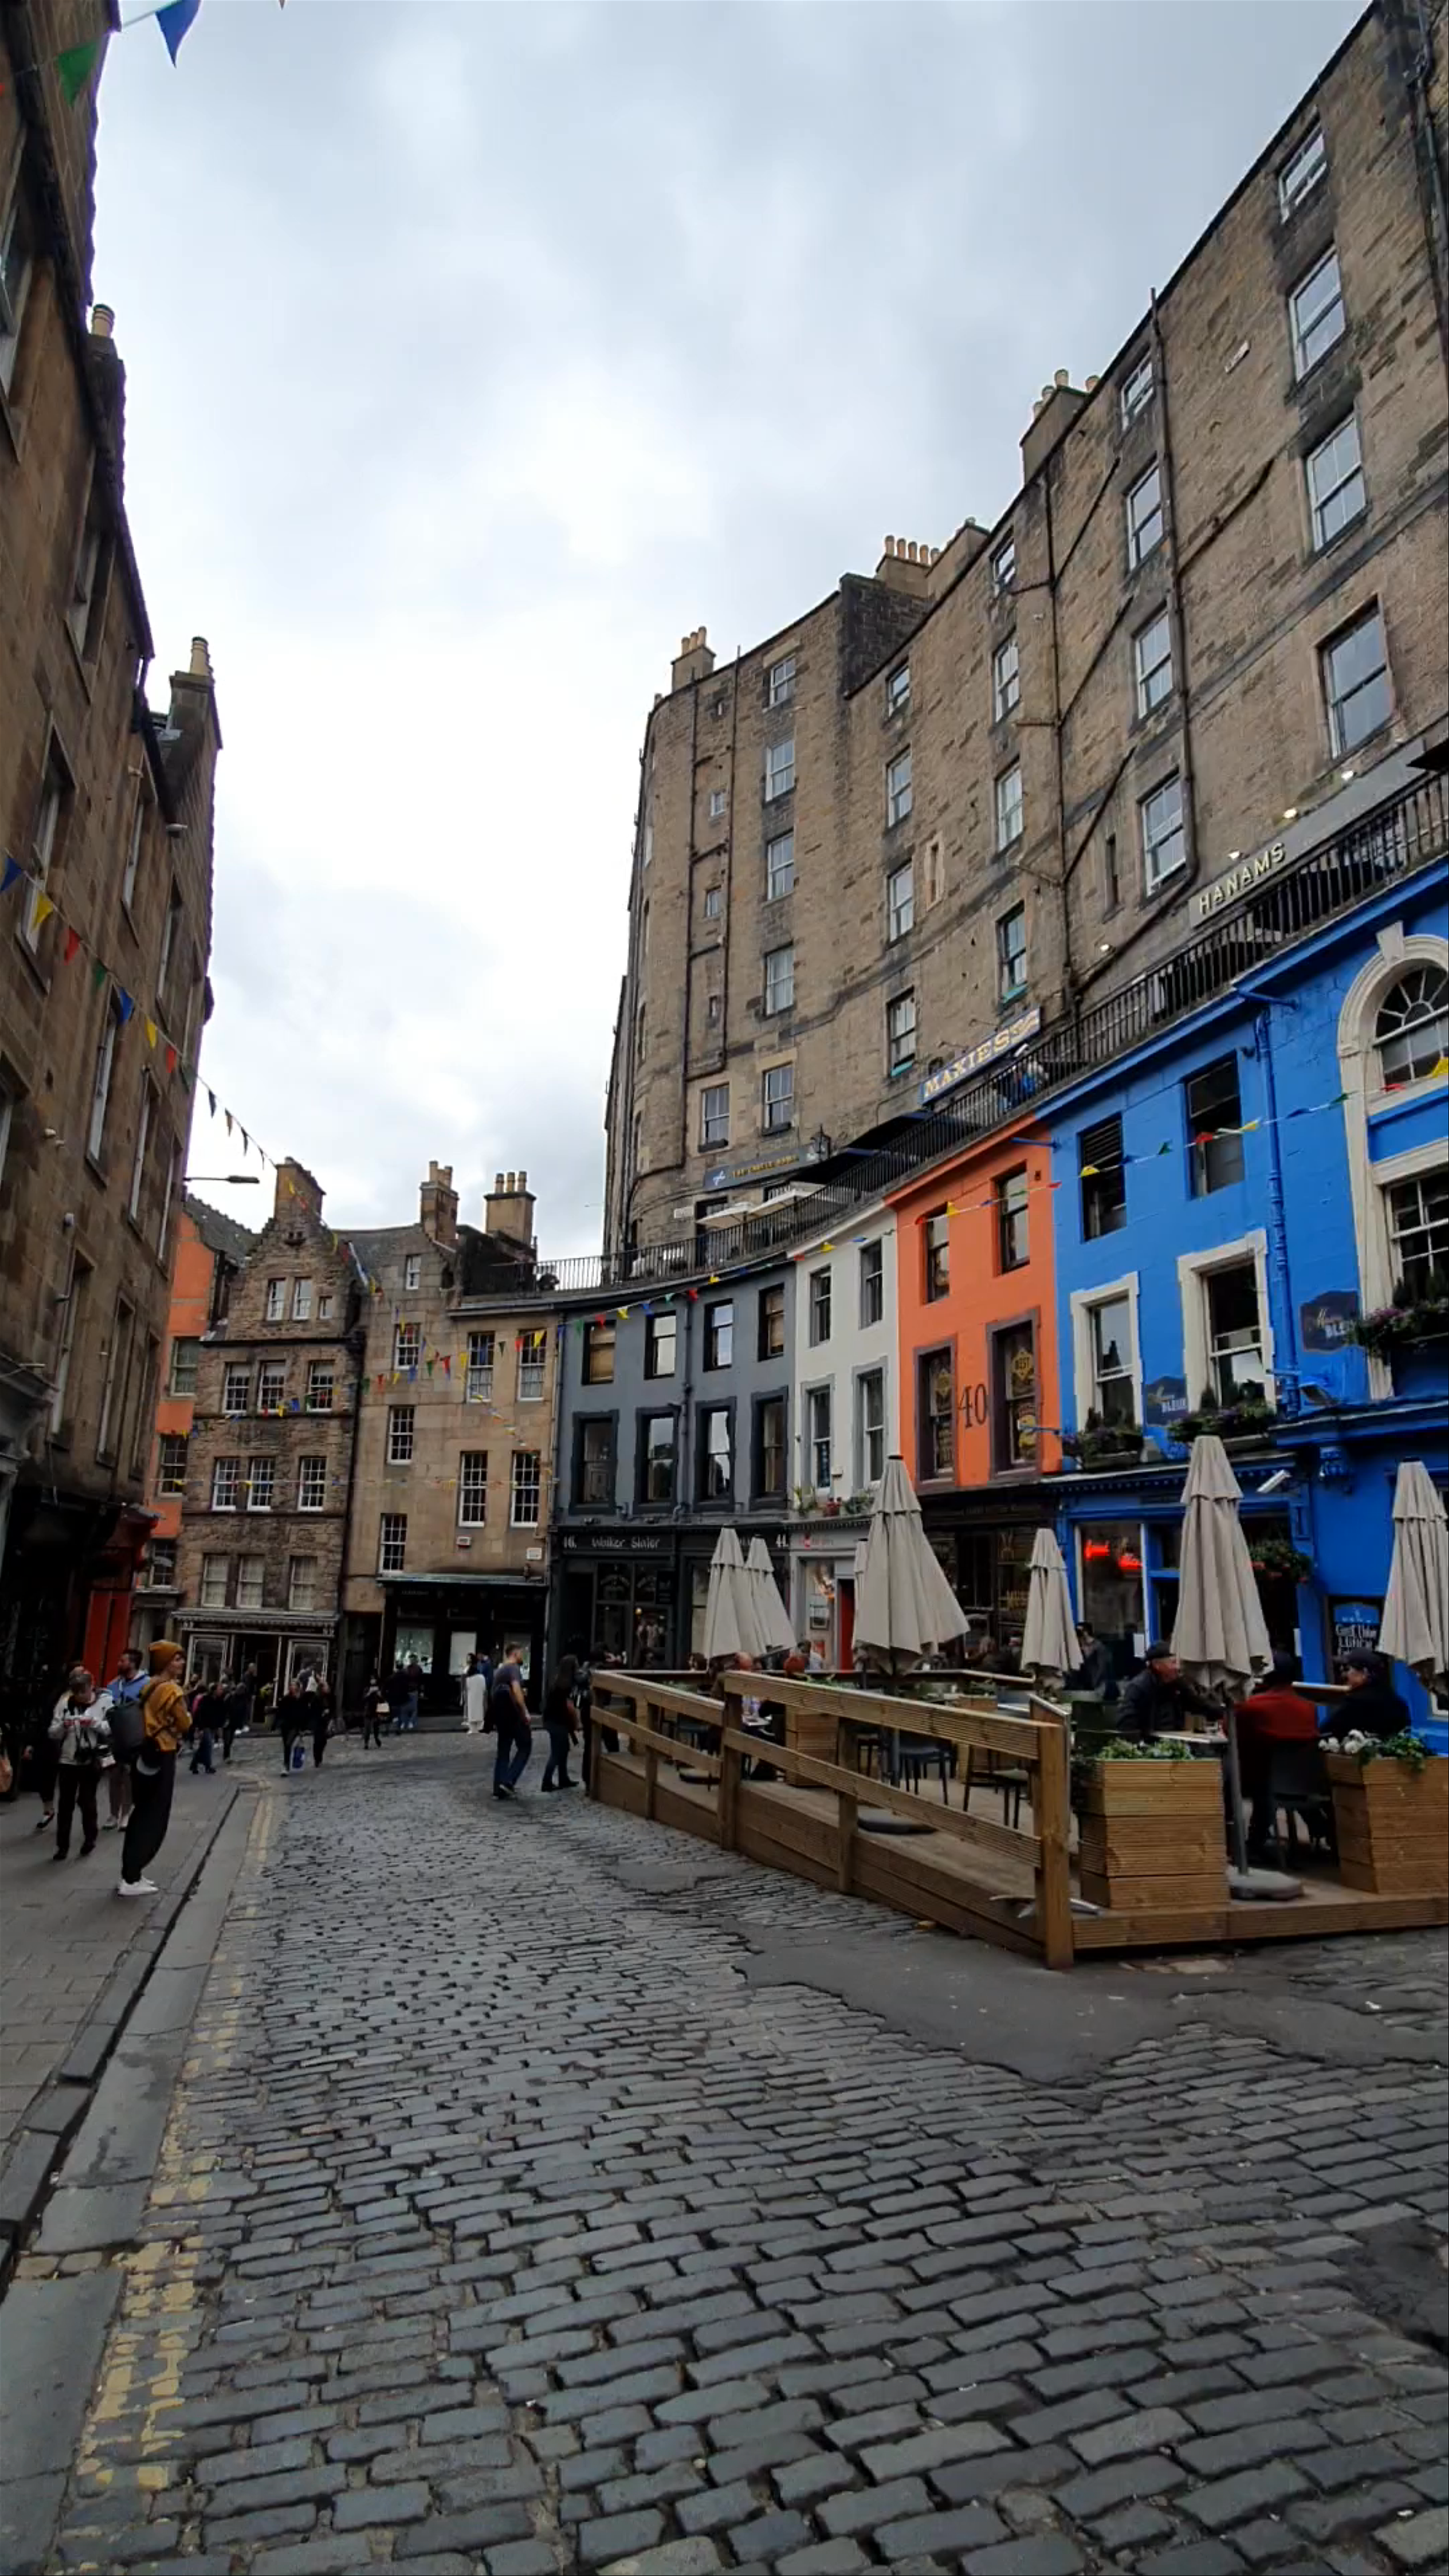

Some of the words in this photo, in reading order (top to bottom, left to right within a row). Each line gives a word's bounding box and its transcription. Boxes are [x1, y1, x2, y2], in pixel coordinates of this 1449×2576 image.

[1200, 843, 1285, 915] HANAMS
[924, 1029, 1010, 1097] MAXIES
[957, 1384, 986, 1429] 40
